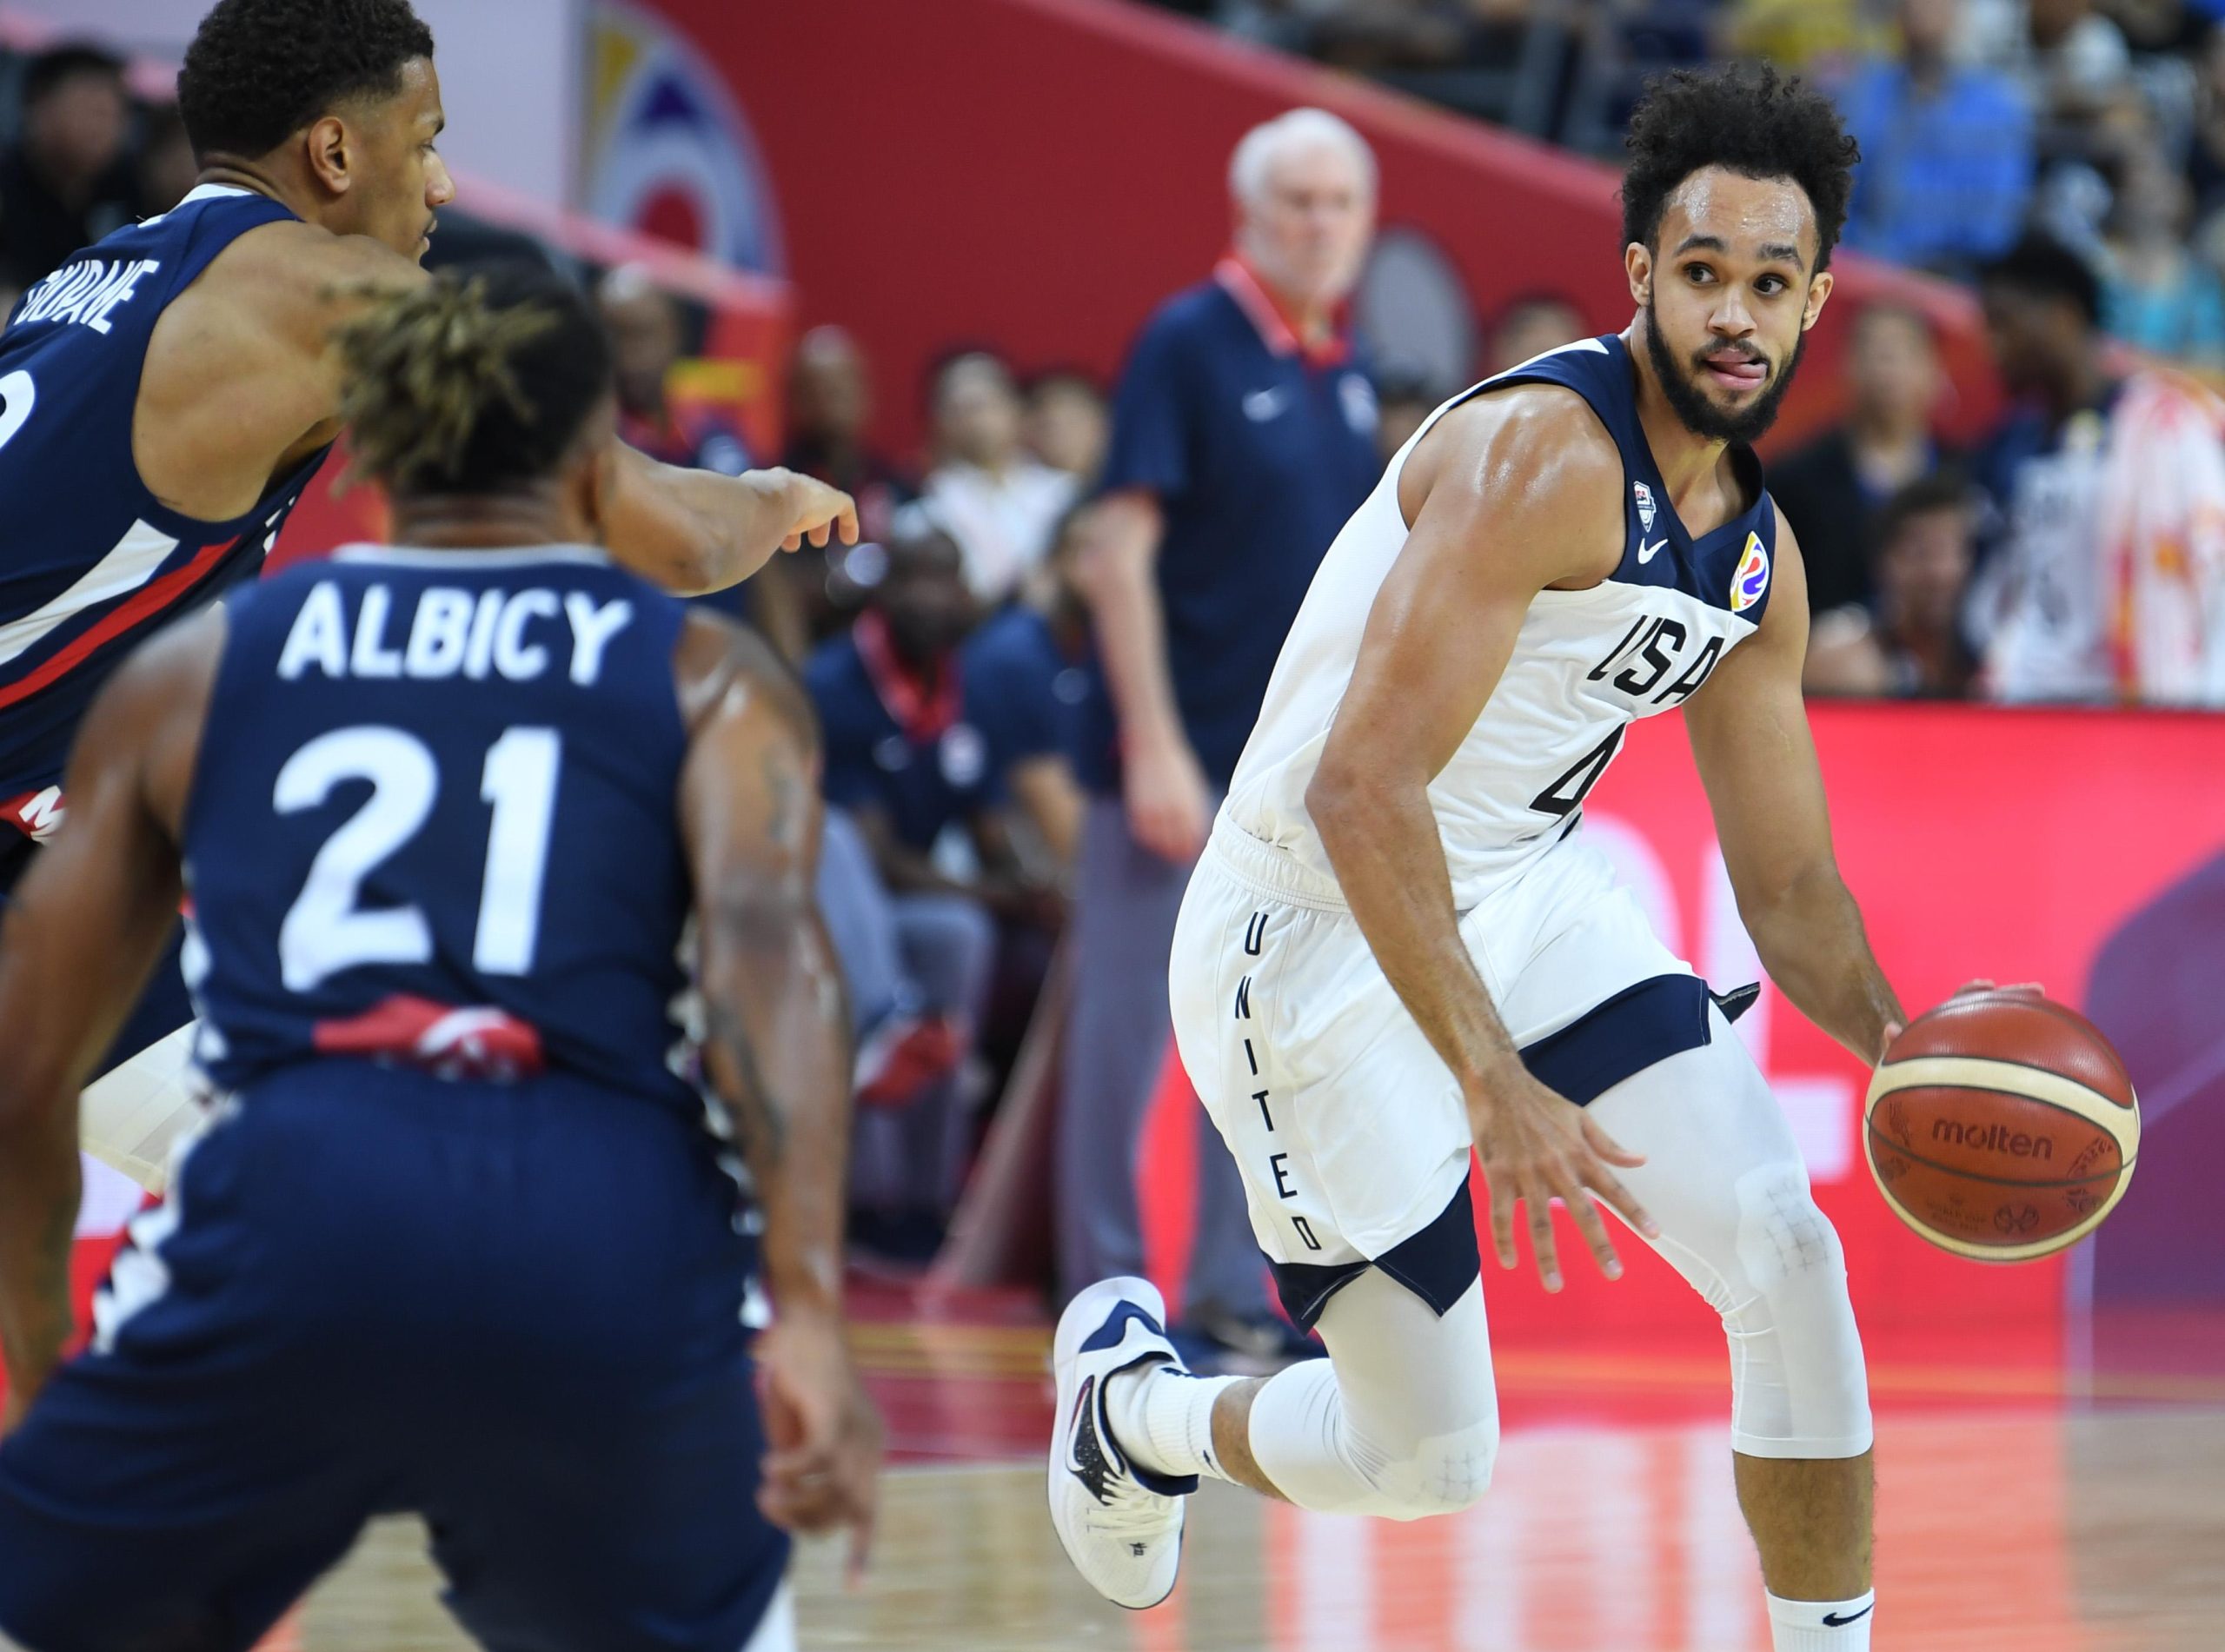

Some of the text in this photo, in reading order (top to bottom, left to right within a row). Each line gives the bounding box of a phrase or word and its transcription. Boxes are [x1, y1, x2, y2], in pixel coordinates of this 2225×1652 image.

[276, 581, 632, 687] ALBICY
[1586, 614, 1725, 705] USA
[1528, 720, 1628, 829] 4
[272, 724, 562, 992] 21
[1234, 910, 1323, 1251] UNITED
[1932, 1117, 2054, 1161] molten
